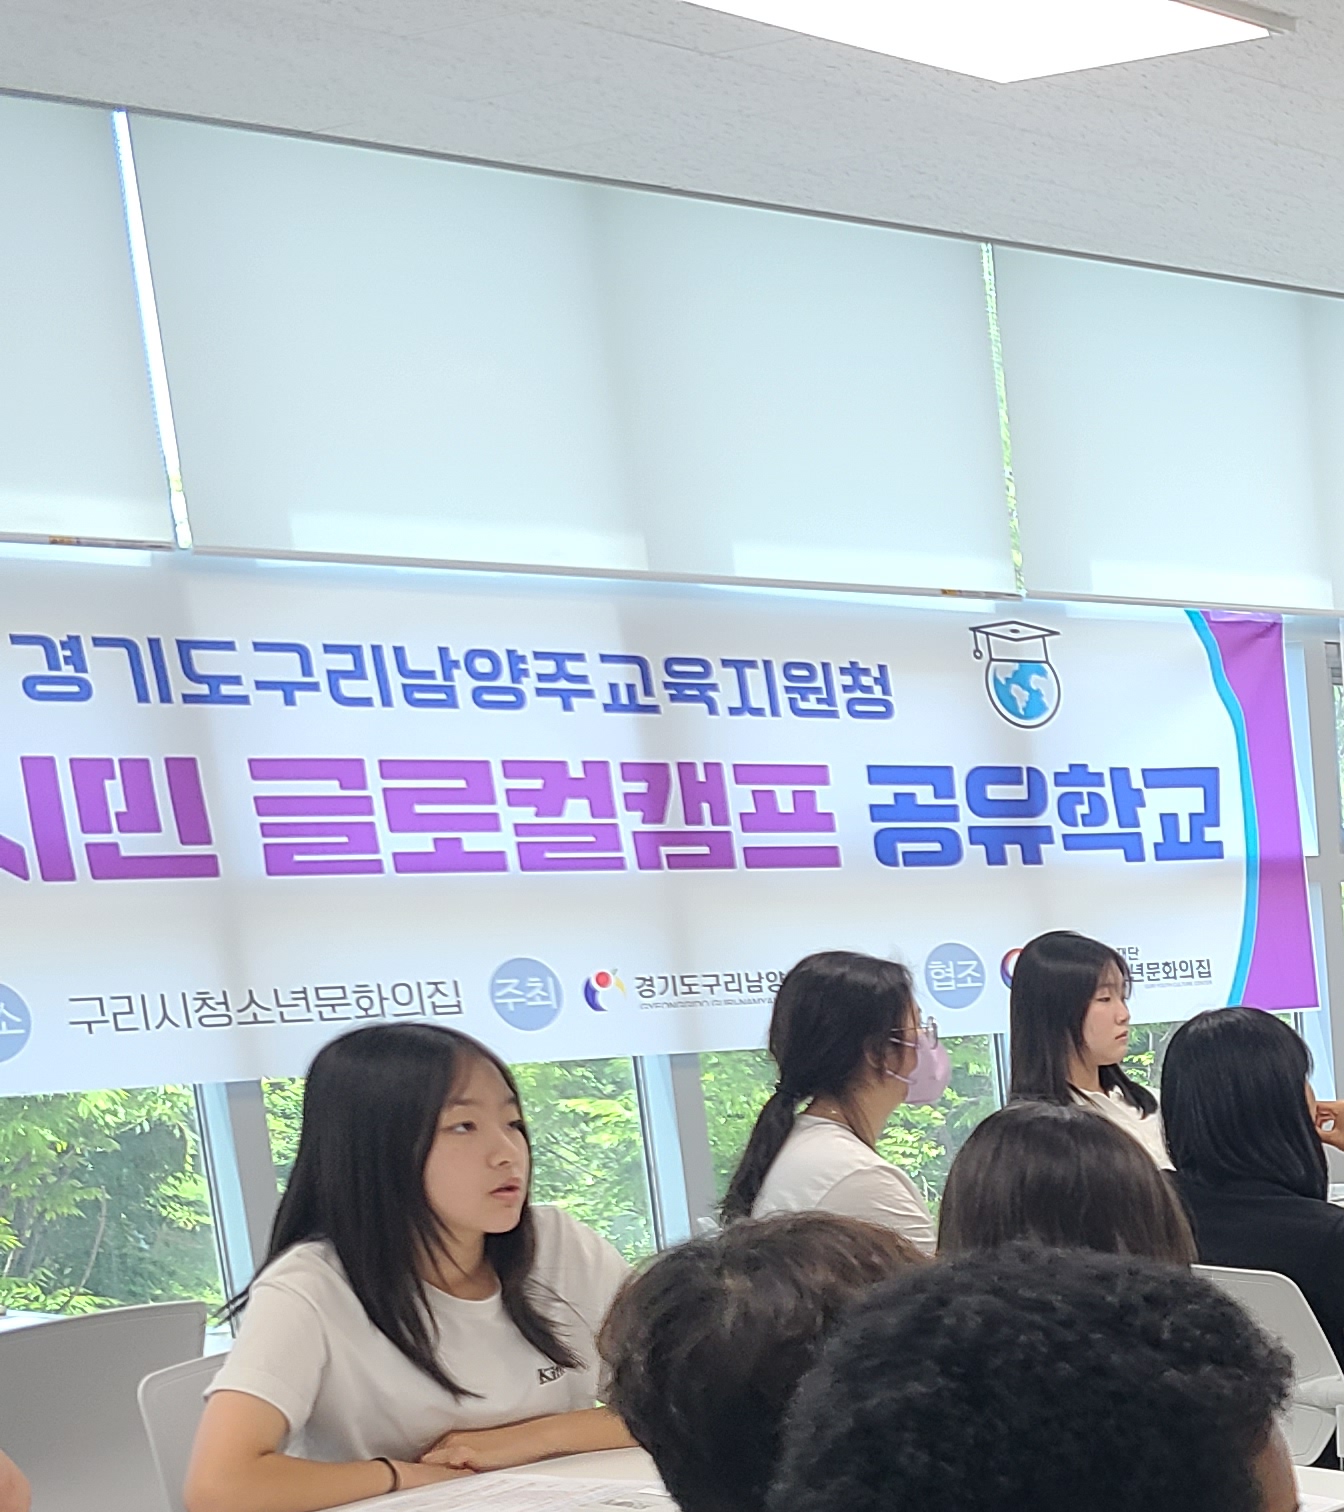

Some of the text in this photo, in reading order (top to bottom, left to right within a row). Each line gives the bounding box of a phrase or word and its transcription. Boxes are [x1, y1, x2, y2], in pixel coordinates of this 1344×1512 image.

[9, 633, 895, 721] 경기도구리남양주교육지원청
[247, 757, 842, 876] 글로컬캠프
[865, 763, 1225, 868] 공유학교
[494, 976, 560, 1012] 주최
[928, 959, 983, 991] 협조
[68, 978, 464, 1035] 구리시청소년문화의집
